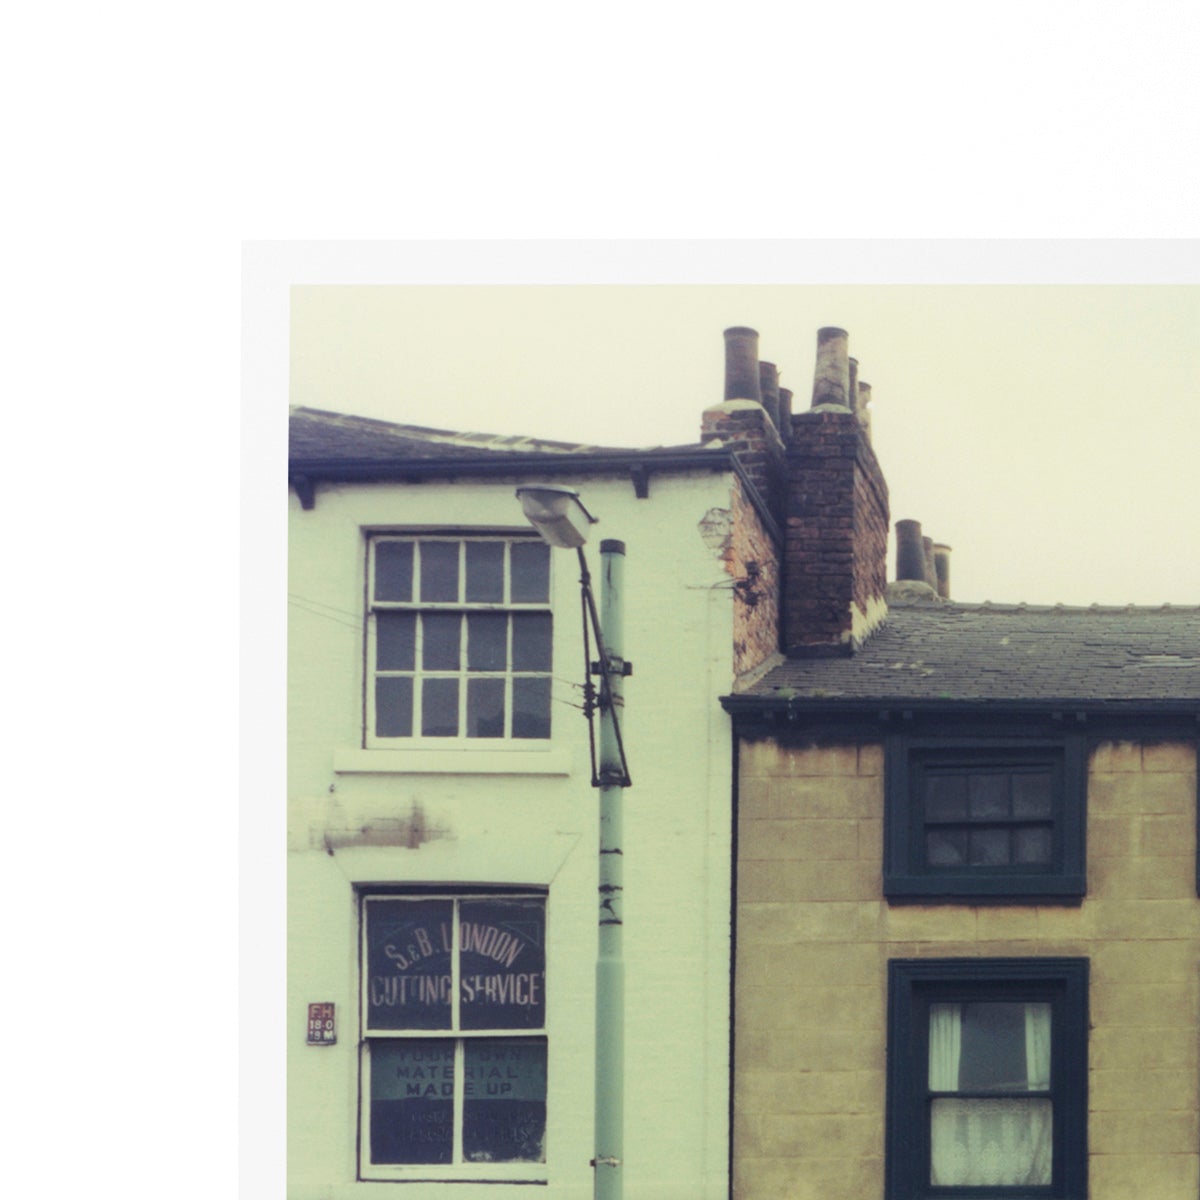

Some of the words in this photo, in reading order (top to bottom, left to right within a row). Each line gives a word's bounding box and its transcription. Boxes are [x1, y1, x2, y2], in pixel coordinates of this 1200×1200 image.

[441, 921, 525, 968] LONDON
[462, 973, 540, 1005] SERVICE
[396, 1066, 518, 1079] MATERIAL
[406, 1083, 475, 1096] MADE
[487, 1082, 512, 1095] UP
